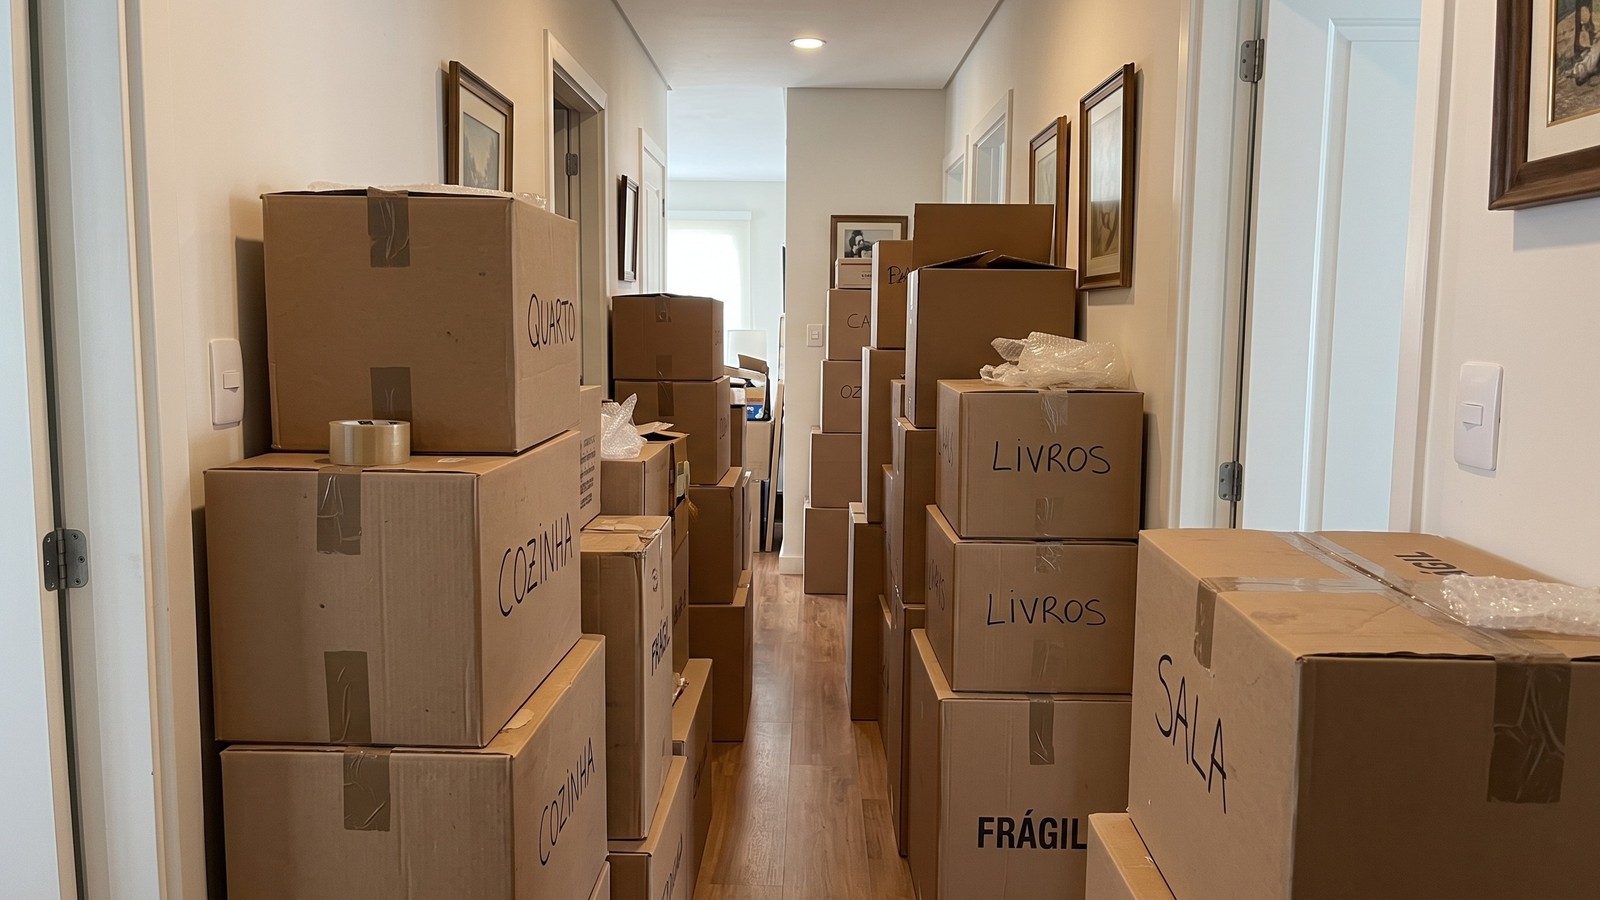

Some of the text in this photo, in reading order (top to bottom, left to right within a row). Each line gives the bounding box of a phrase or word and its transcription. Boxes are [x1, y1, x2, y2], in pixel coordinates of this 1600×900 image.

[528, 293, 576, 351] QUARTO
[993, 438, 1111, 474] LIVROS
[498, 512, 573, 617] COZINHA
[987, 589, 1106, 626] LIVROS
[1155, 654, 1227, 815] SALA
[539, 737, 595, 866] COZINHA
[977, 809, 1087, 849] FRÁGIL
